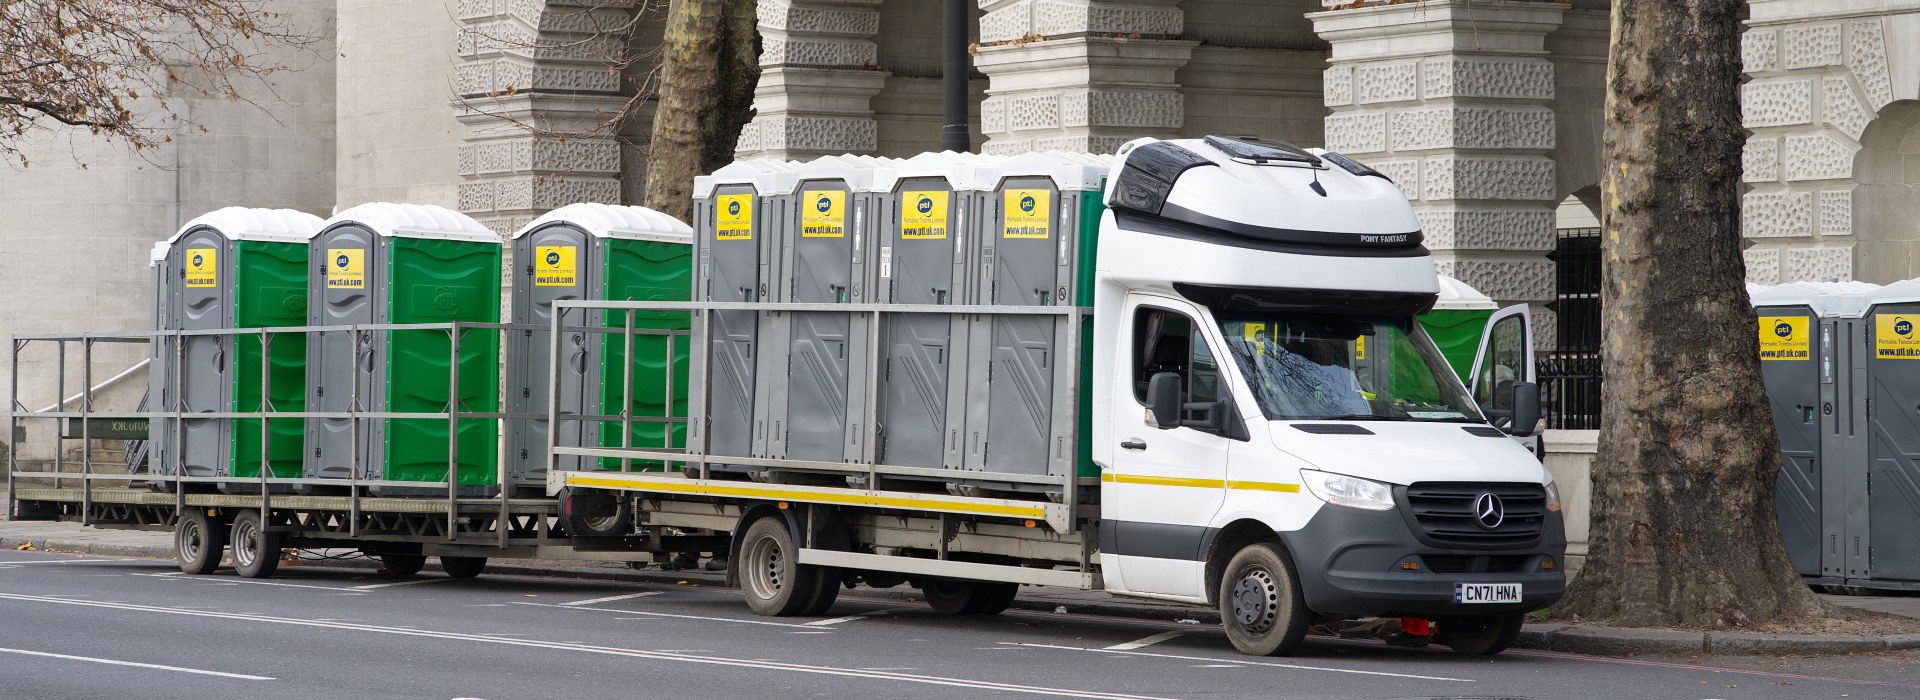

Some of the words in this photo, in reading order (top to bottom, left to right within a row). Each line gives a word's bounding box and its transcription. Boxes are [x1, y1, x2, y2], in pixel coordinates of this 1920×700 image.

[804, 226, 843, 235] www.ptl.uk.com
[903, 227, 945, 236] www.ptl.uk.com
[1006, 226, 1047, 236] www.ptl.uk.com
[1360, 234, 1379, 243] PONY
[1380, 234, 1407, 243] FANTASY
[1777, 325, 1789, 335] ptl
[1897, 323, 1910, 333] ptl
[1761, 349, 1808, 359] www.ptl.uk.com
[1466, 585, 1493, 601] CN71
[1496, 585, 1517, 600] HNA
